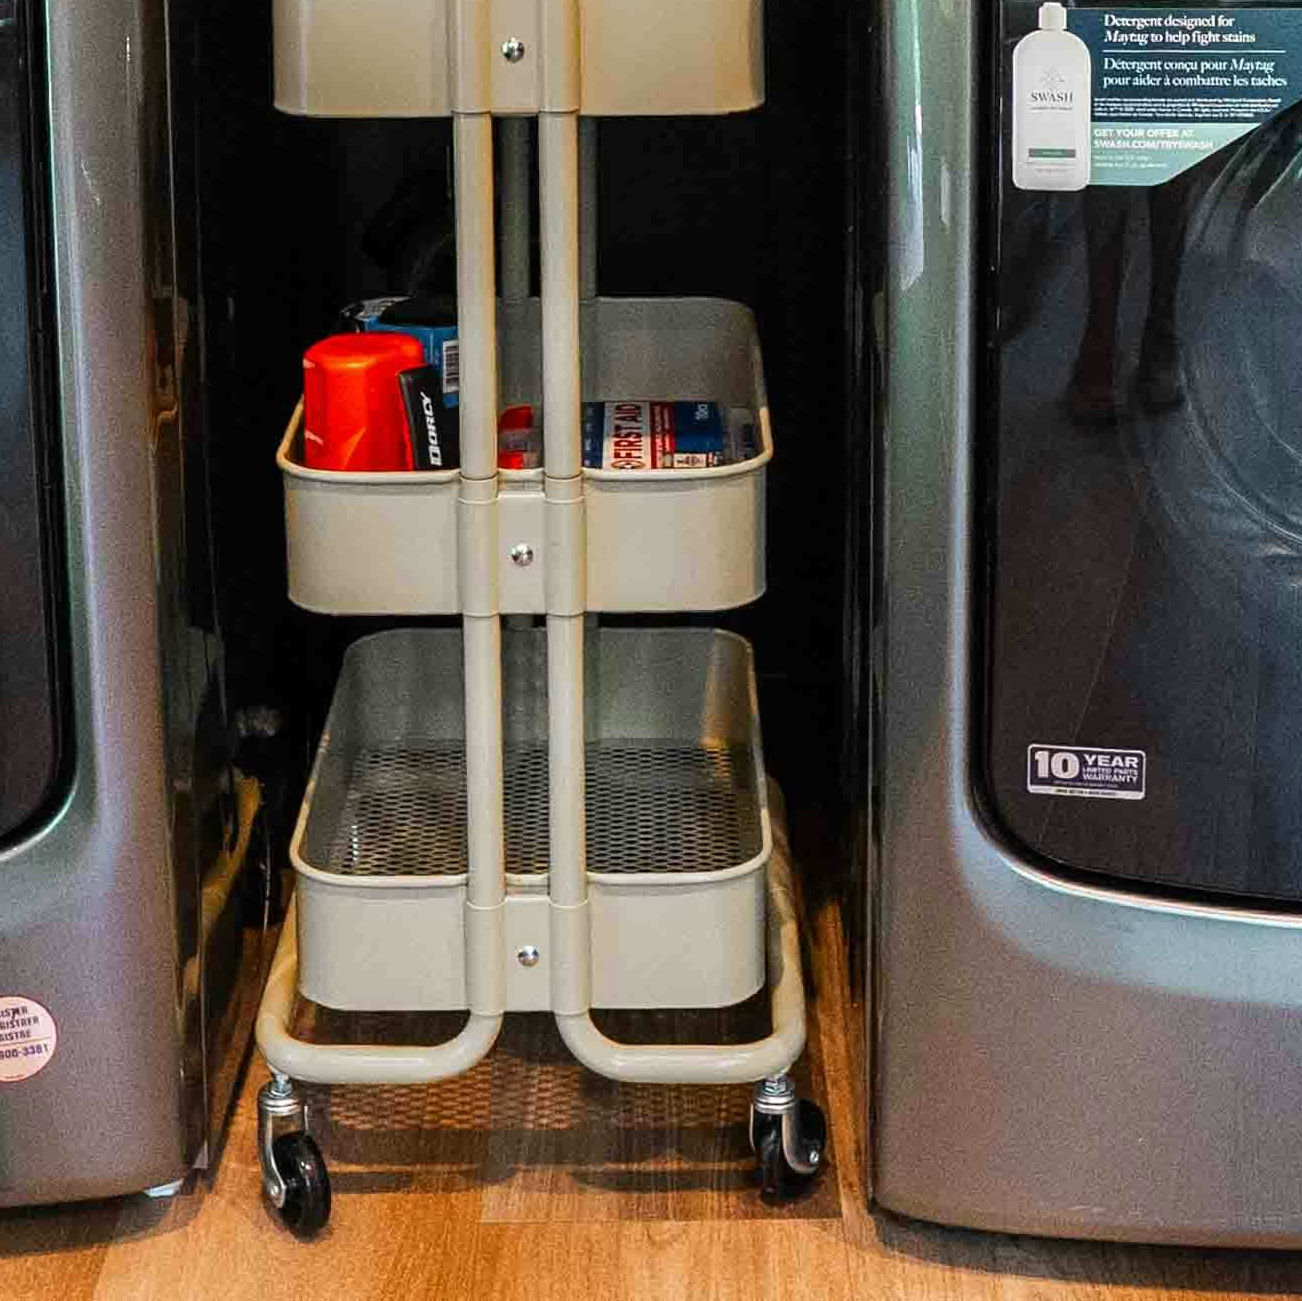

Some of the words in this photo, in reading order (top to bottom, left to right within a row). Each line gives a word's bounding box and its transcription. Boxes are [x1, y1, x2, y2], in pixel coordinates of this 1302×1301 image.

[1103, 13, 1162, 31] Detergent
[1164, 13, 1216, 31] designed
[1217, 14, 1236, 27] for
[1103, 30, 1149, 46] Maytag
[1150, 31, 1164, 43] to
[1165, 30, 1191, 46] help
[1191, 30, 1221, 46] fight
[1222, 31, 1256, 43] stains
[1103, 57, 1162, 74] Détergent
[1163, 60, 1198, 74] conçu
[1200, 60, 1228, 73] pour
[1229, 57, 1276, 74] Maytag
[1103, 76, 1131, 89] pour
[1132, 74, 1161, 87] aider
[1163, 74, 1170, 87] à
[1171, 74, 1232, 87] combattre
[1233, 74, 1249, 87] les
[1250, 74, 1288, 87] taches
[1030, 91, 1074, 104] SWASH
[1116, 128, 1145, 139] YOUR
[613, 404, 643, 423] AID
[419, 390, 443, 467] DORCY
[613, 426, 644, 459] FIRST
[1035, 750, 1080, 779] 10
[1083, 753, 1139, 768] YEAR
[1083, 773, 1139, 784] WARRANTY
